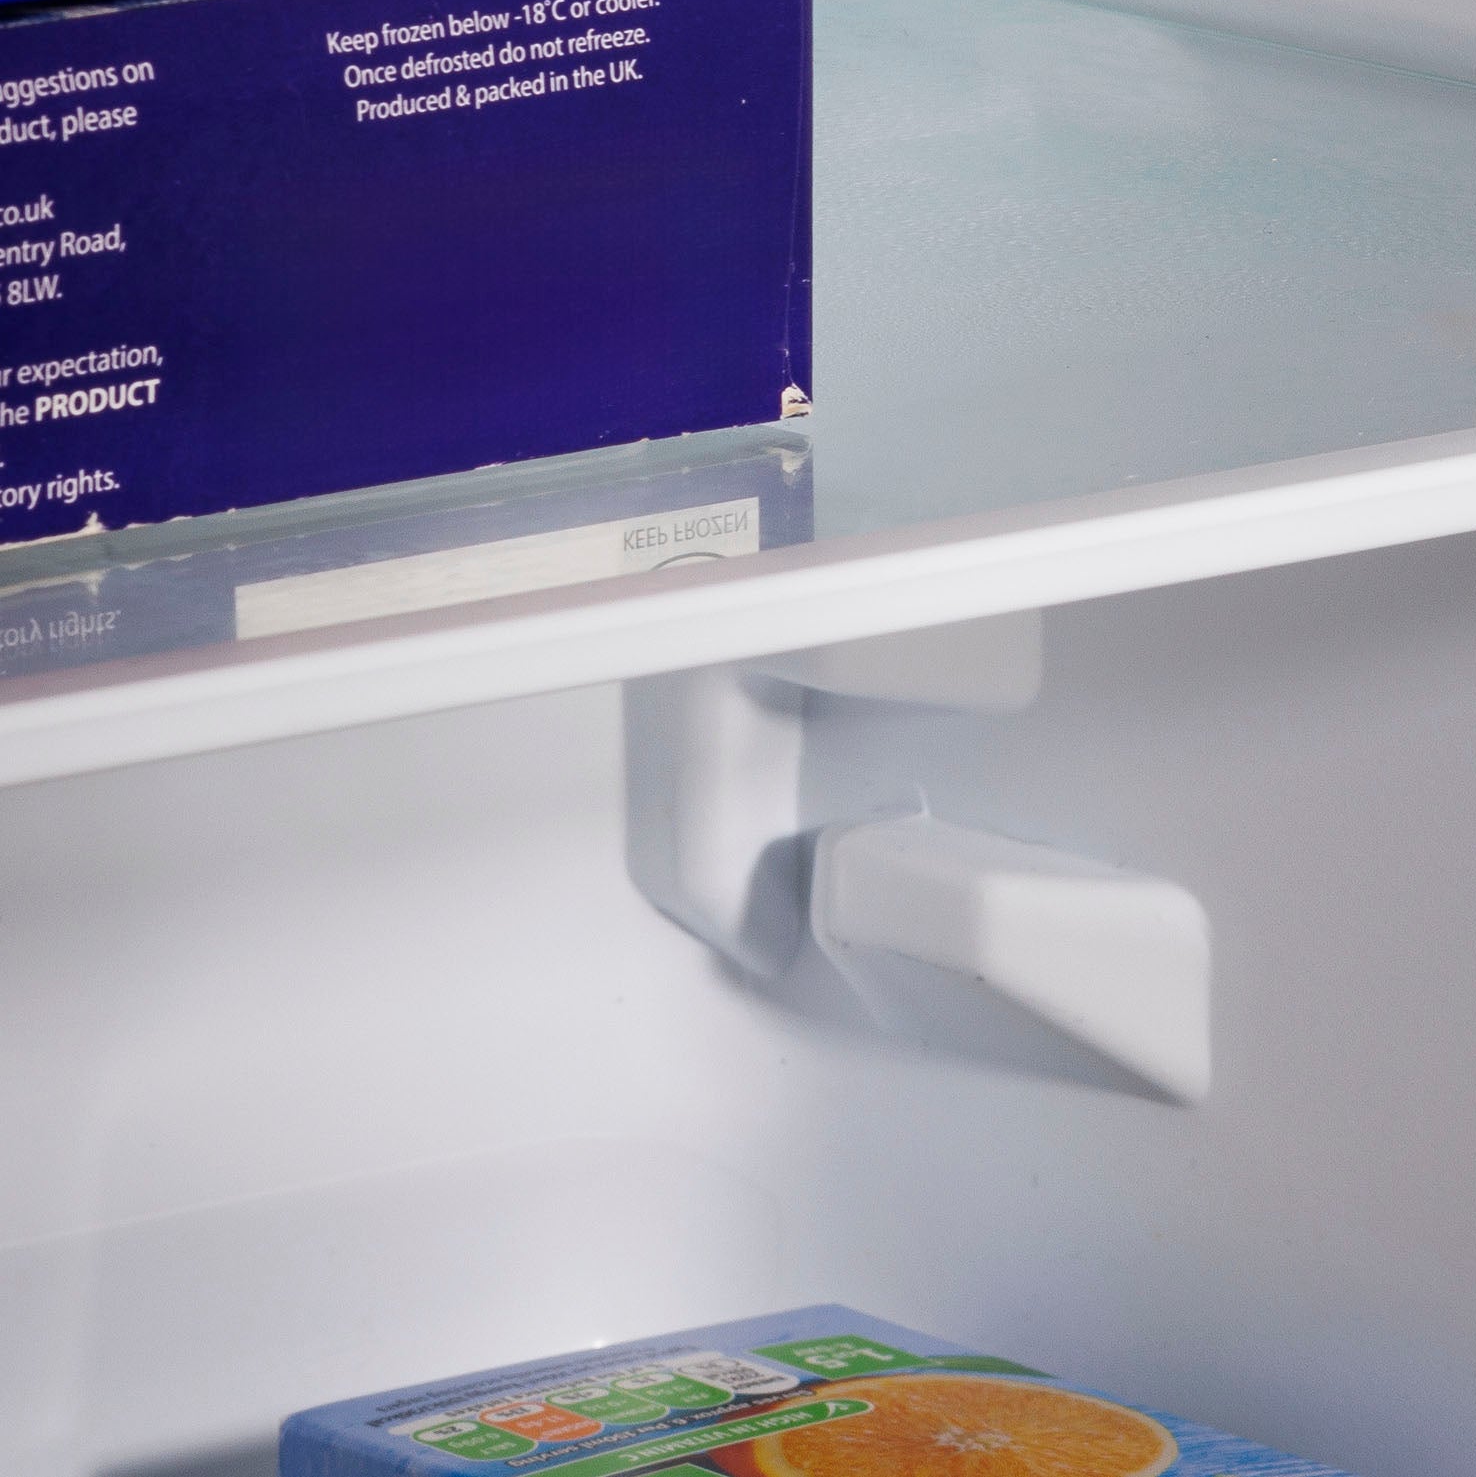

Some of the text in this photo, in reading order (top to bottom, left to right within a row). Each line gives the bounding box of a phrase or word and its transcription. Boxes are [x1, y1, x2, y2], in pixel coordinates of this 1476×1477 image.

[326, 31, 379, 55] Keep
[382, 22, 446, 46] frozen
[448, 10, 510, 37] below
[570, 0, 591, 18] or
[344, 28, 651, 88] Once defrosted do not refreeze.
[0, 62, 154, 108] ggestions on
[356, 58, 643, 122] Produced & packed in the UK.
[62, 106, 138, 142] please
[0, 194, 55, 227] o.uk
[60, 223, 126, 257] Road,
[7, 274, 62, 305] 8LW.
[17, 344, 163, 387] expectation,
[35, 378, 161, 421] PRODUCT
[0, 468, 120, 510] ory rights.
